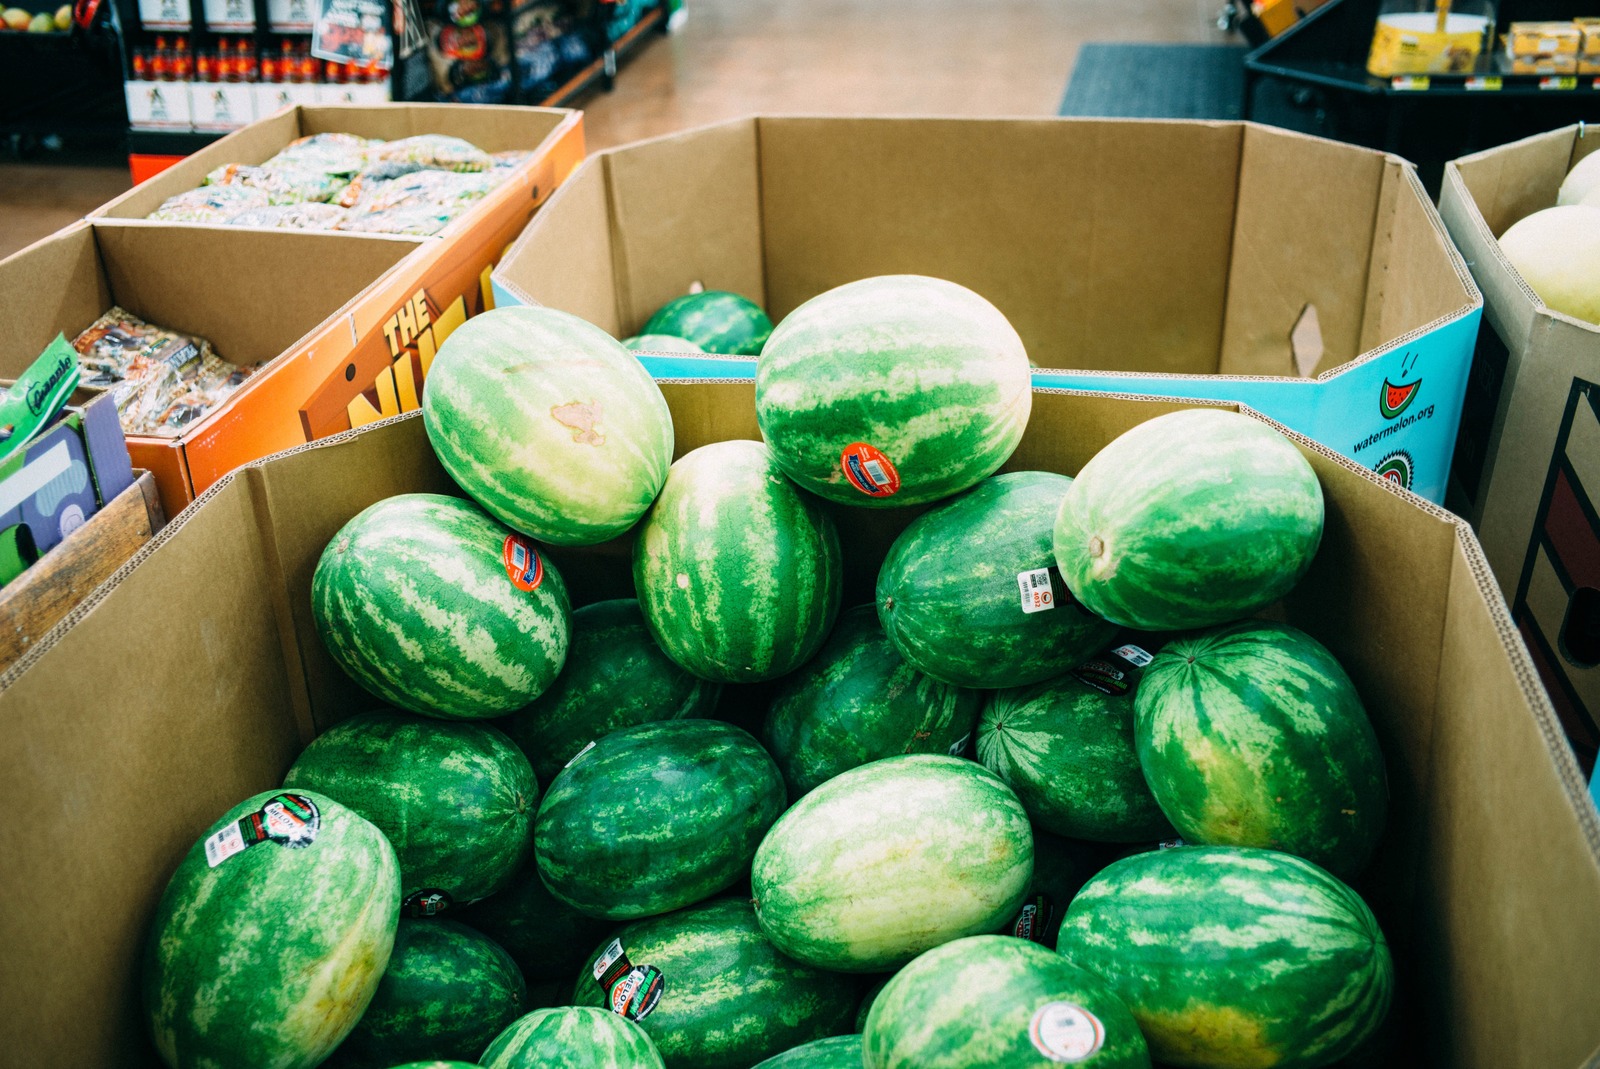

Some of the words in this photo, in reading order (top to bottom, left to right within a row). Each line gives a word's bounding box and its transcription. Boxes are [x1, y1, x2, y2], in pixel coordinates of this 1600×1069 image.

[383, 288, 431, 359] THE
[1354, 404, 1435, 453] watermelon.org
[1033, 592, 1041, 608] 4032
